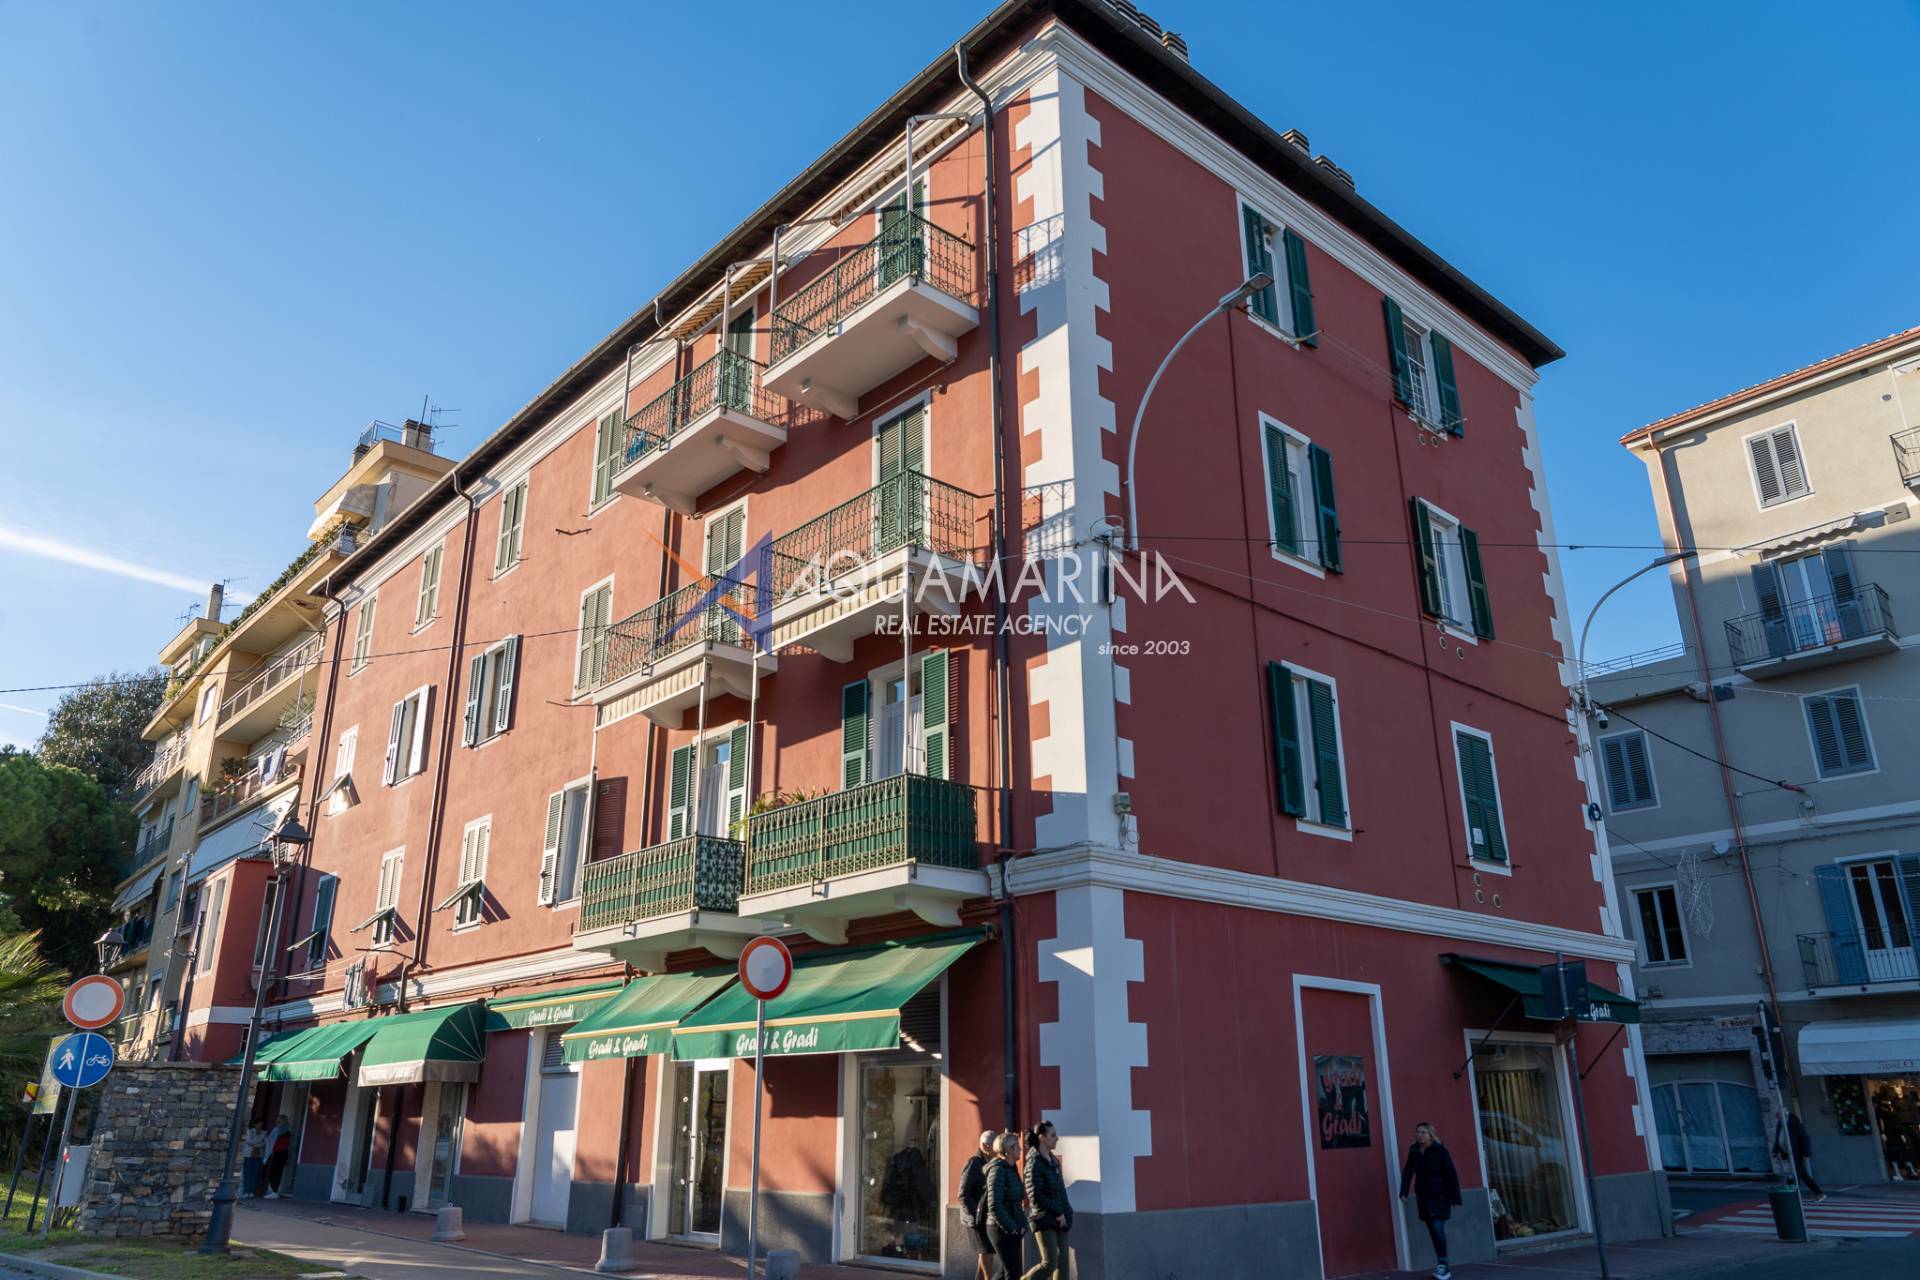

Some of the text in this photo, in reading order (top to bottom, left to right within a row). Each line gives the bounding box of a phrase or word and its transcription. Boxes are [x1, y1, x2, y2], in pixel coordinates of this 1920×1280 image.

[1590, 1003, 1611, 1021] Gradi
[588, 1032, 648, 1059] Gradi & Gradi
[736, 1027, 819, 1057] Grai & Gradi
[1322, 1111, 1362, 1141] Gradi
